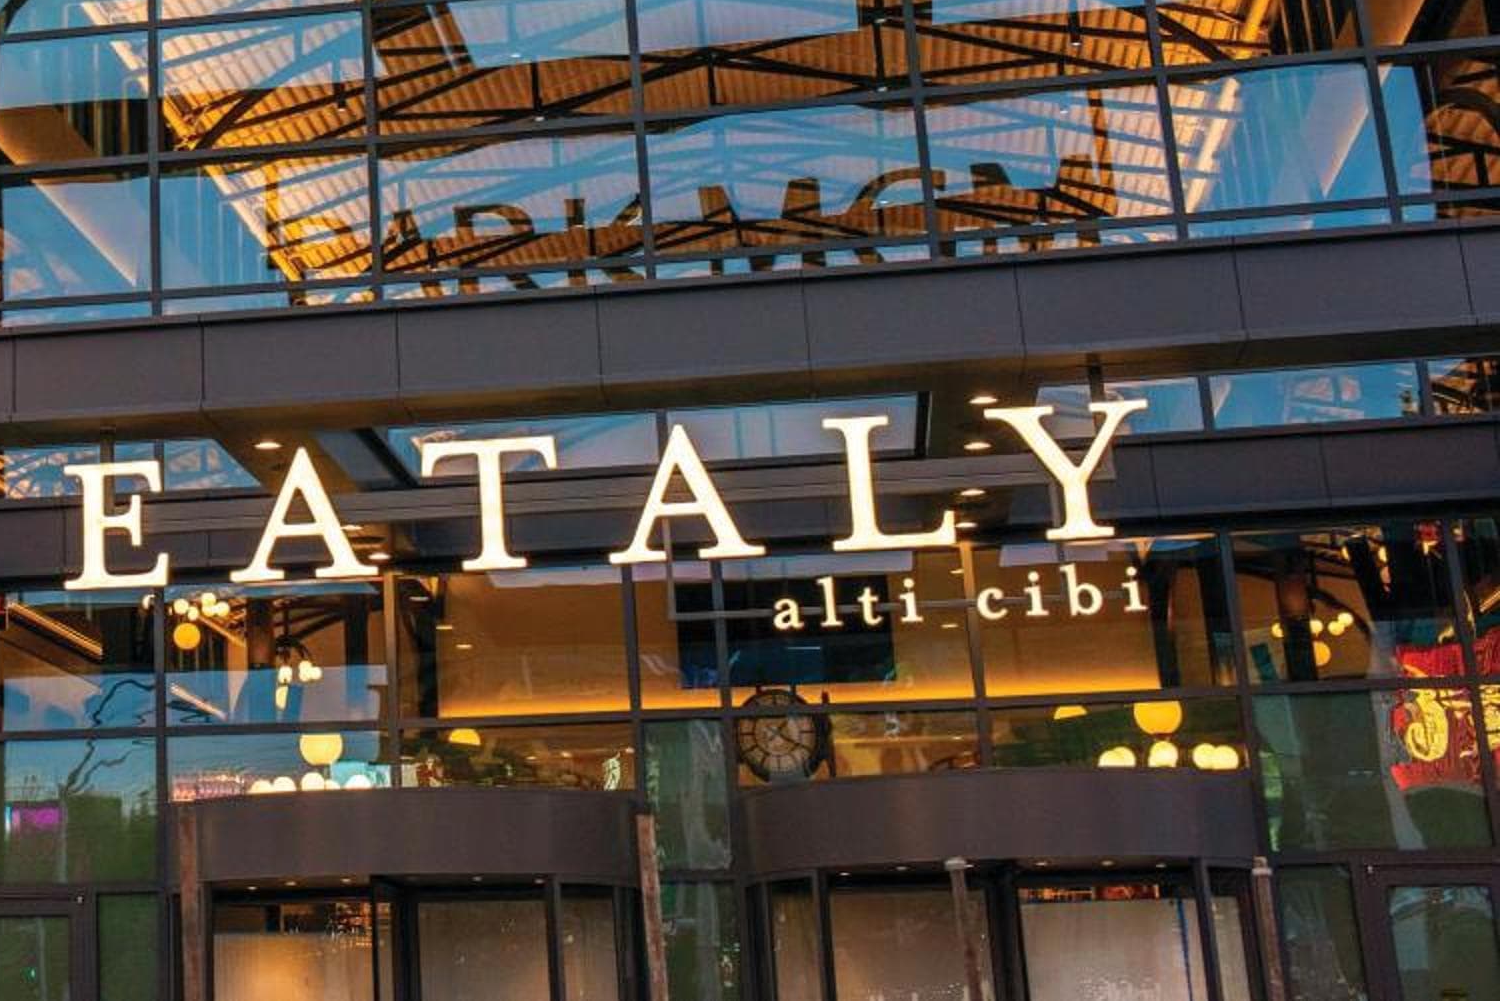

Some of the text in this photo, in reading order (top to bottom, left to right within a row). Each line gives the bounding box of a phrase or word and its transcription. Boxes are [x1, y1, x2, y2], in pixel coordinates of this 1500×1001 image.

[63, 395, 1148, 591] EATALY
[772, 563, 1148, 630] alti cibi
